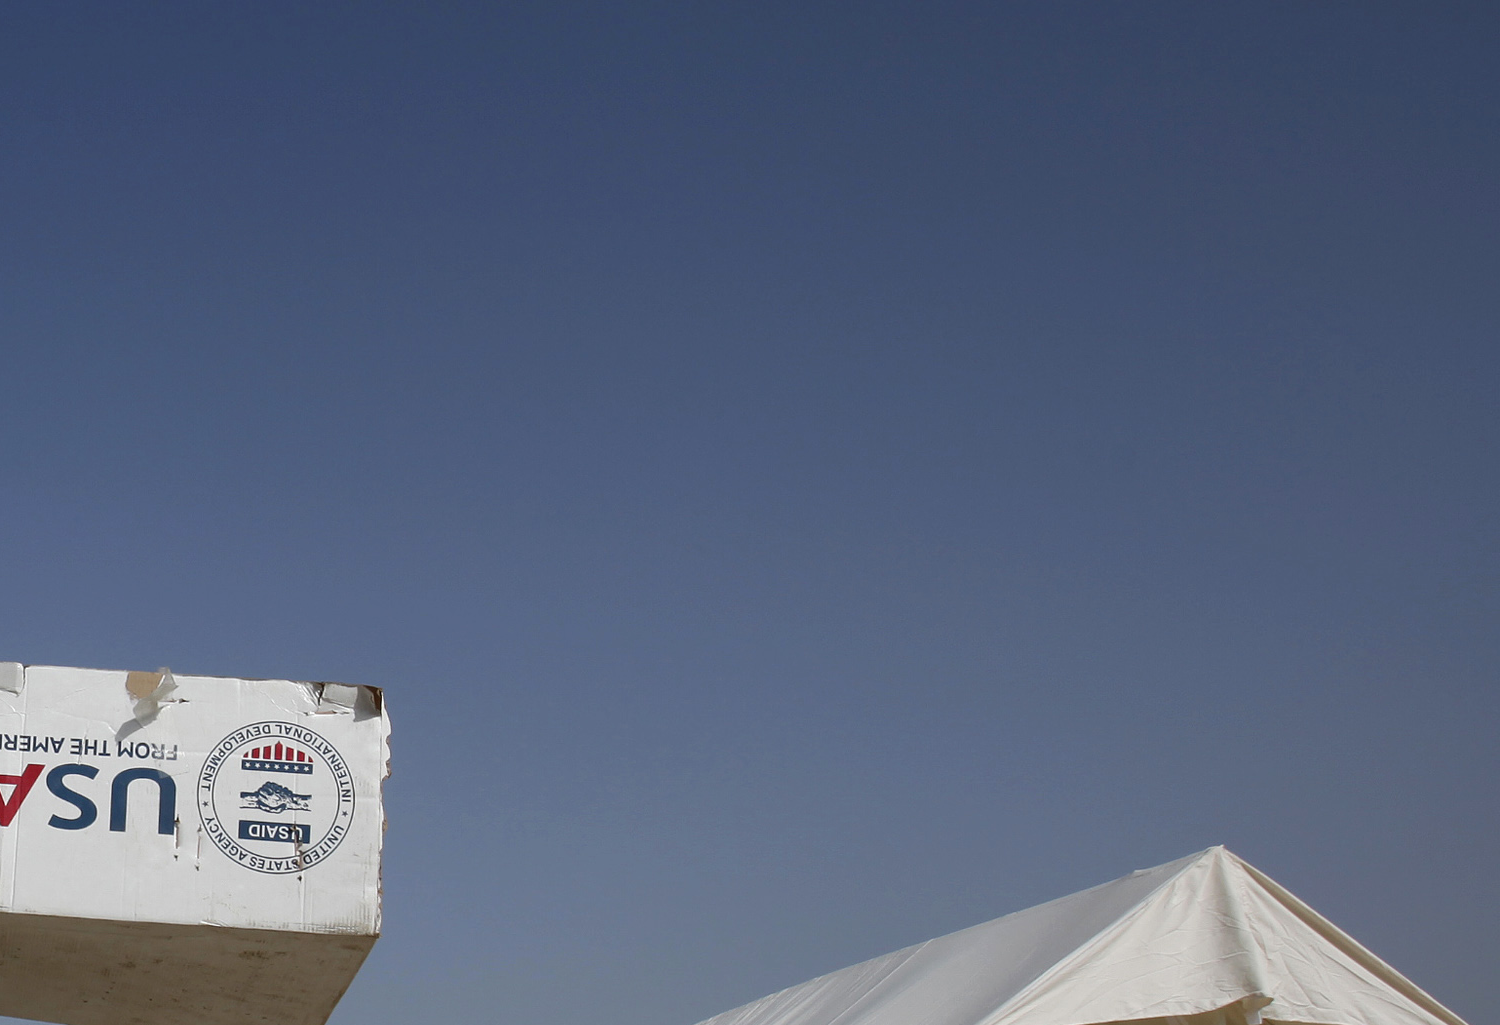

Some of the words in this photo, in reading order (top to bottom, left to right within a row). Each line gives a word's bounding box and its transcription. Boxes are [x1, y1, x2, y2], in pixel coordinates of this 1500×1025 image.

[70, 738, 111, 757] THE
[117, 741, 178, 761] FROM
[201, 724, 271, 792] DEVELOPMENT
[274, 724, 351, 803] INTERNATIONAL
[204, 816, 247, 862] AGENCY
[248, 824, 303, 841] USAID
[303, 824, 345, 866] UNITED
[249, 856, 300, 871] STATES
